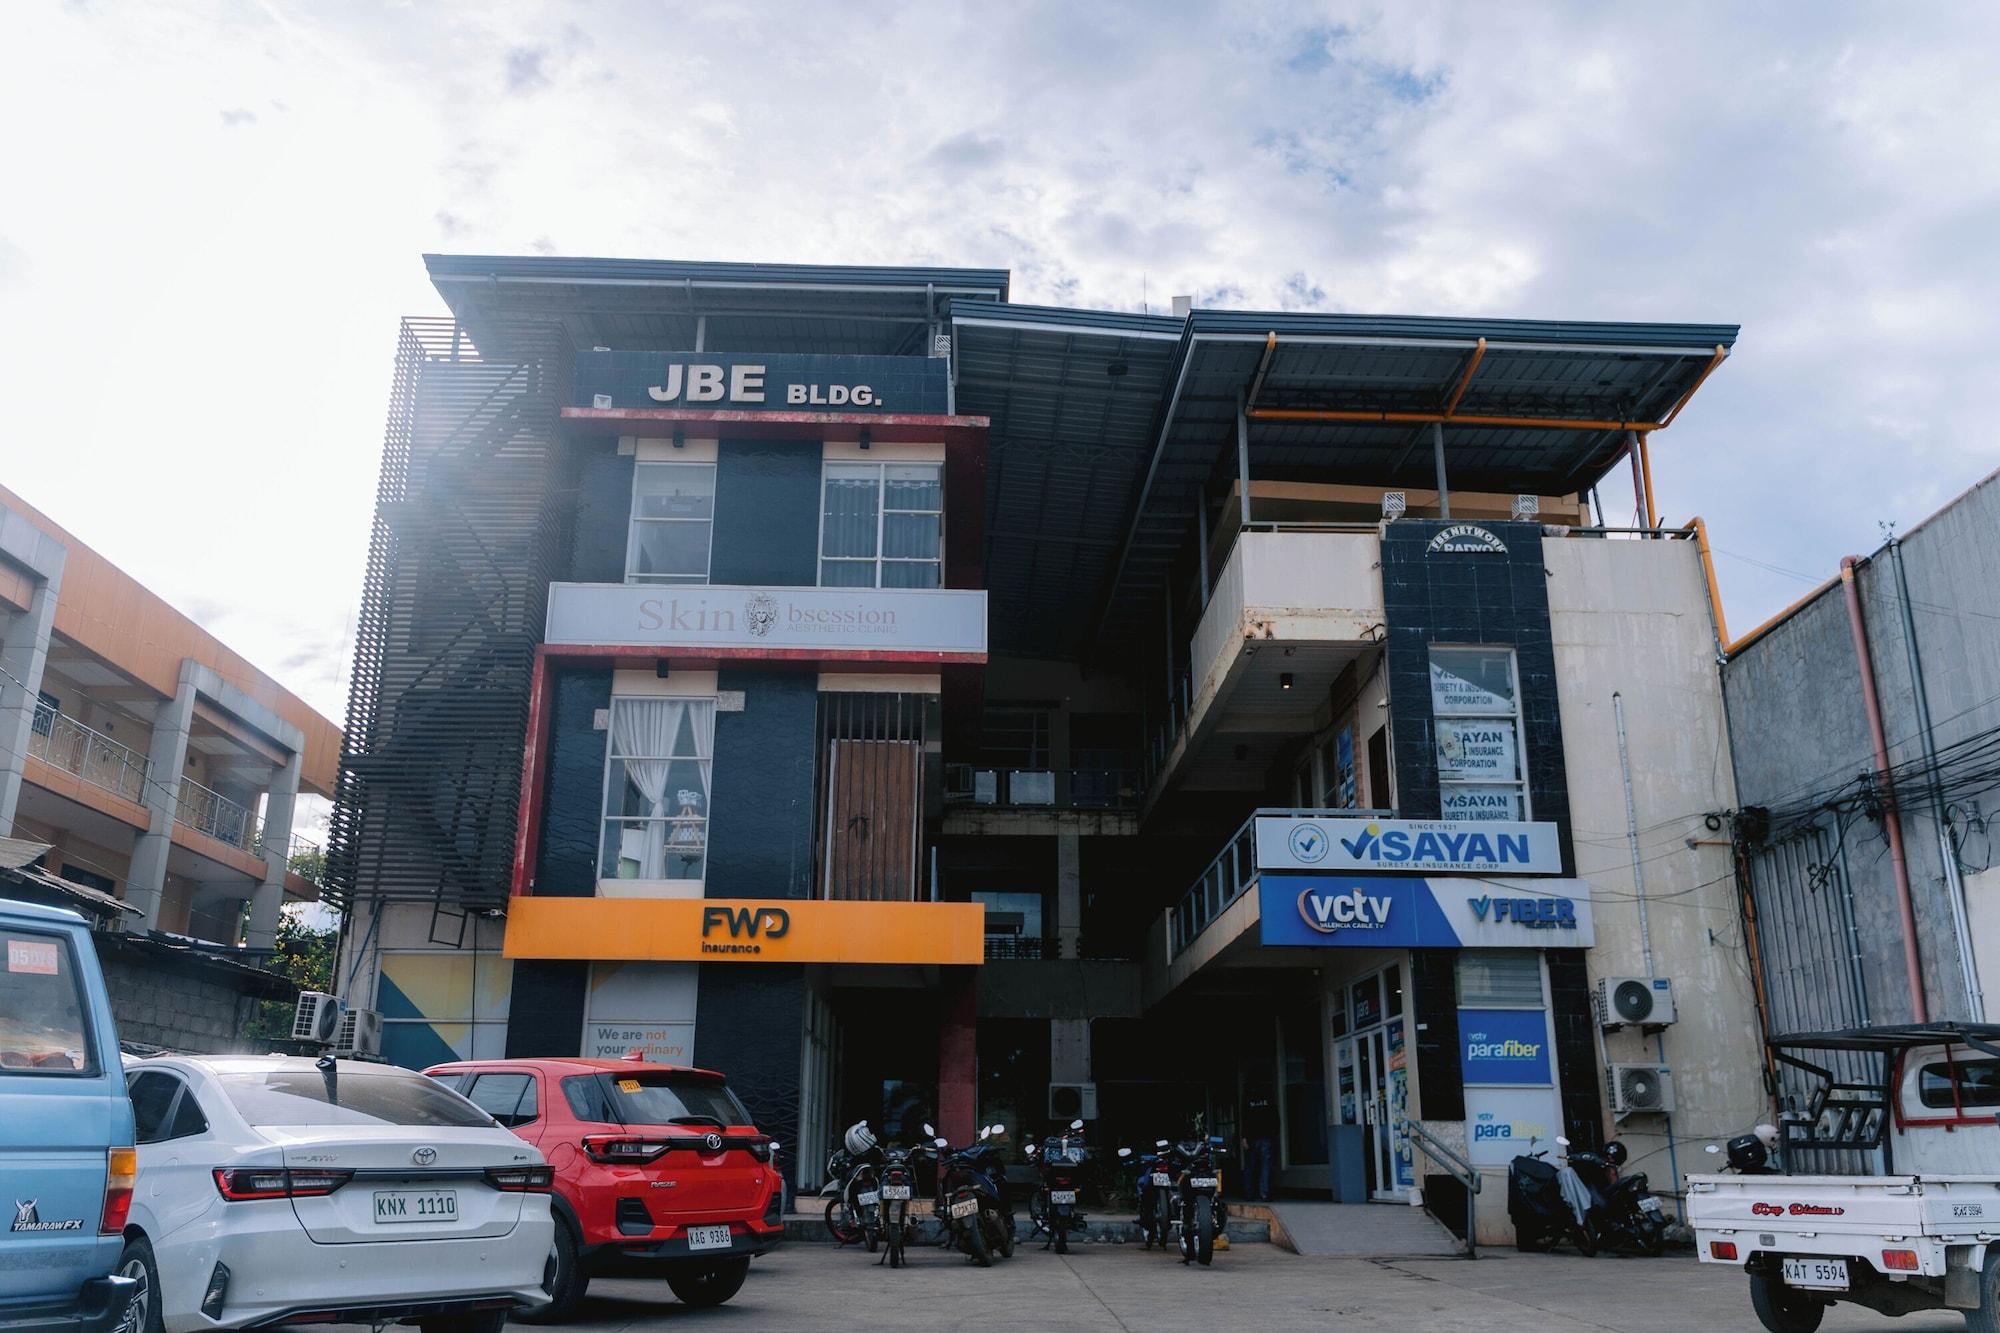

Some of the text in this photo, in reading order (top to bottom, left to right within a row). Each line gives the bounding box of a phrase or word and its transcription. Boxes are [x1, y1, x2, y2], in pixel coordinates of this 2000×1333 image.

[647, 363, 884, 407] JBE BLDG.
[637, 599, 735, 632] Skin
[786, 623, 900, 635] AESTHETIC CLINIC
[1444, 696, 1493, 705] CORPORATION
[1469, 746, 1504, 756] INSURANCE
[1450, 759, 1498, 768] CORPORATION
[1376, 861, 1410, 869] SURETY
[1422, 862, 1472, 870] INSURANCE
[1310, 887, 1393, 924] vctv
[1493, 897, 1577, 923] FIBER
[702, 906, 790, 939] FWD
[701, 941, 761, 954] insurance
[598, 1028, 667, 1040] We are not
[596, 1044, 684, 1056] your ordinary
[1467, 1040, 1541, 1061] parafiber
[377, 1197, 455, 1215] KNX 1110
[690, 1230, 730, 1245] KAG 9386
[1784, 1263, 1846, 1281] KAT 5594
